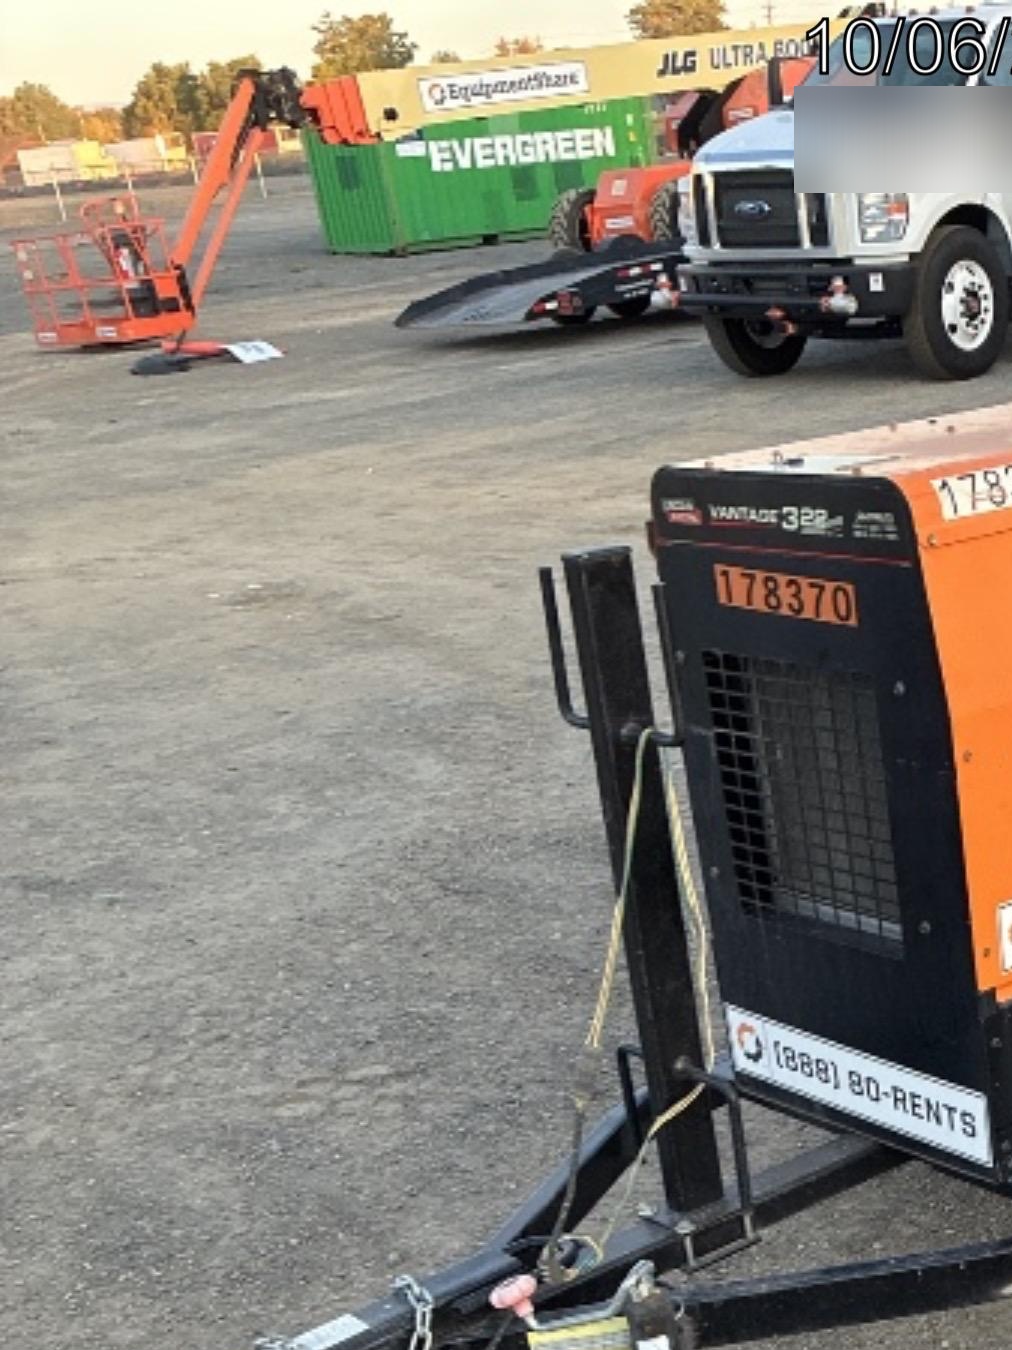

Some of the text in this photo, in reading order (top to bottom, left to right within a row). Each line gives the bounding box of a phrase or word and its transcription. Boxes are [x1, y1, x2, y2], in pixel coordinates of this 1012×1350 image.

[657, 50, 697, 77] JLG
[710, 41, 769, 69] ULTRA
[427, 126, 616, 172] EVERGREEN
[708, 504, 778, 523] VANTAGE
[719, 569, 852, 622] 178370
[773, 1040, 978, 1138] (888) 80-RENTS
